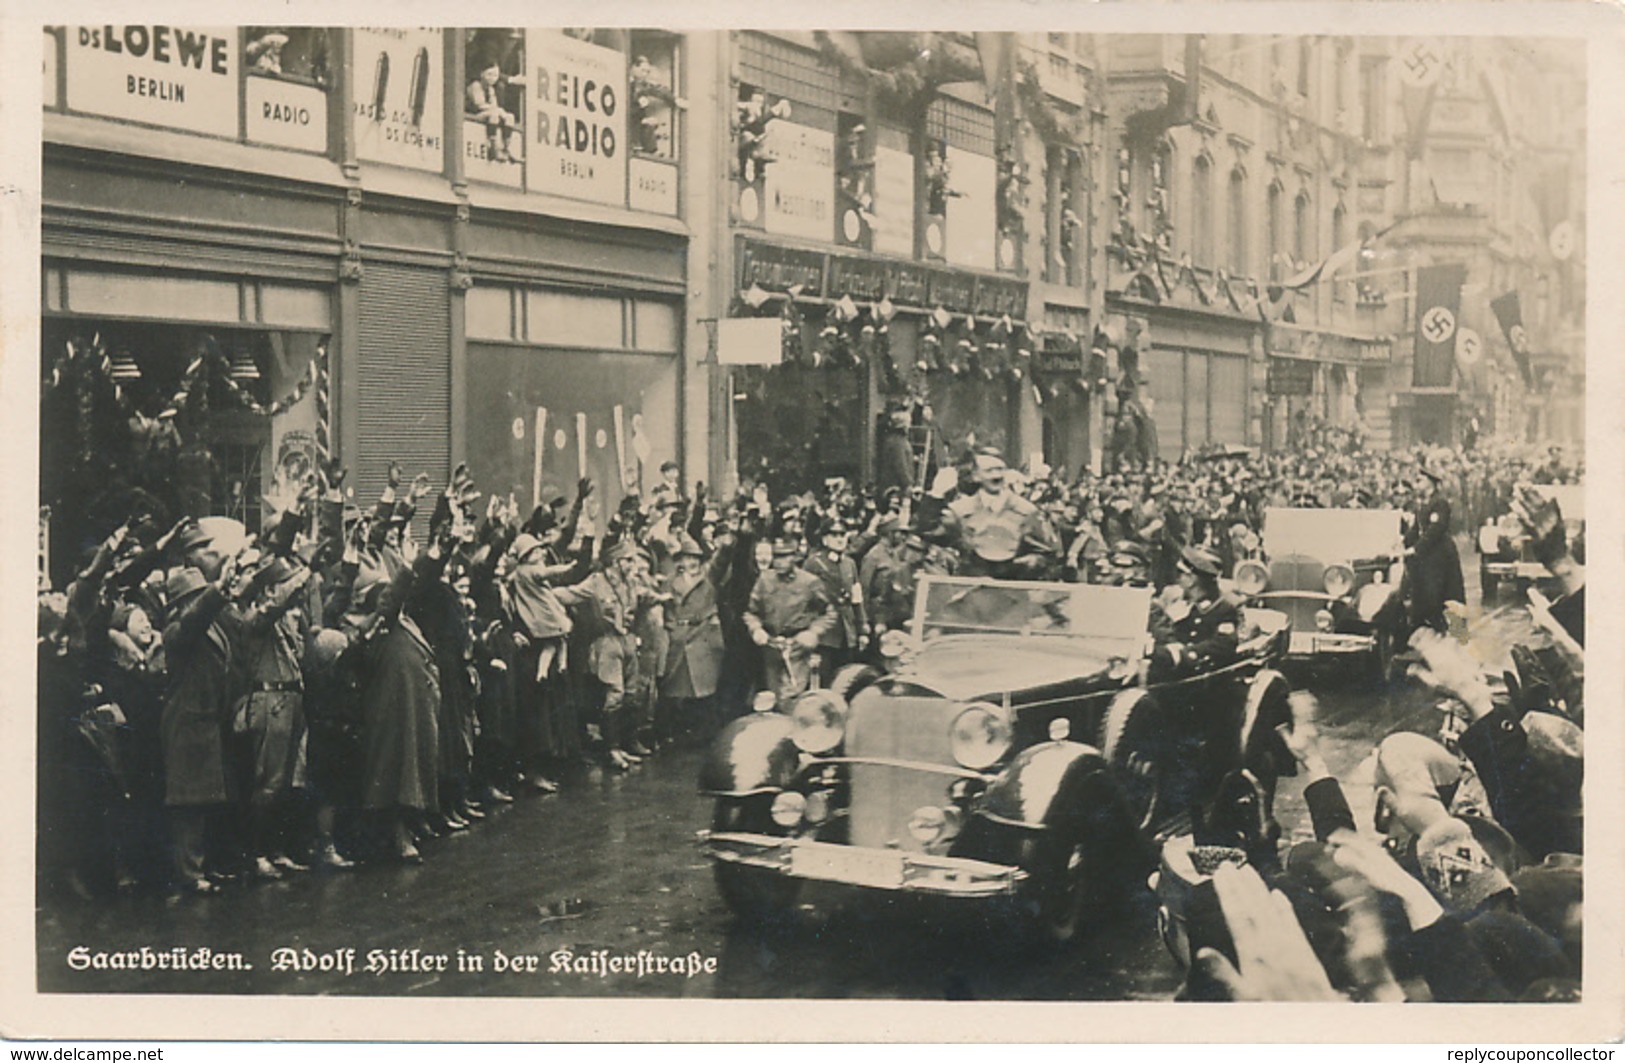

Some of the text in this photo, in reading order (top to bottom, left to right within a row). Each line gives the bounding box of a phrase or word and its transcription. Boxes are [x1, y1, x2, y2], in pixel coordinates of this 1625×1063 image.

[104, 25, 228, 75] LOEWE
[126, 74, 185, 102] BERLIN
[537, 66, 616, 117] REICO
[263, 102, 310, 125] RADIO
[352, 103, 387, 121] ADO
[537, 110, 616, 158] RADIO
[560, 158, 595, 179] BERLIN
